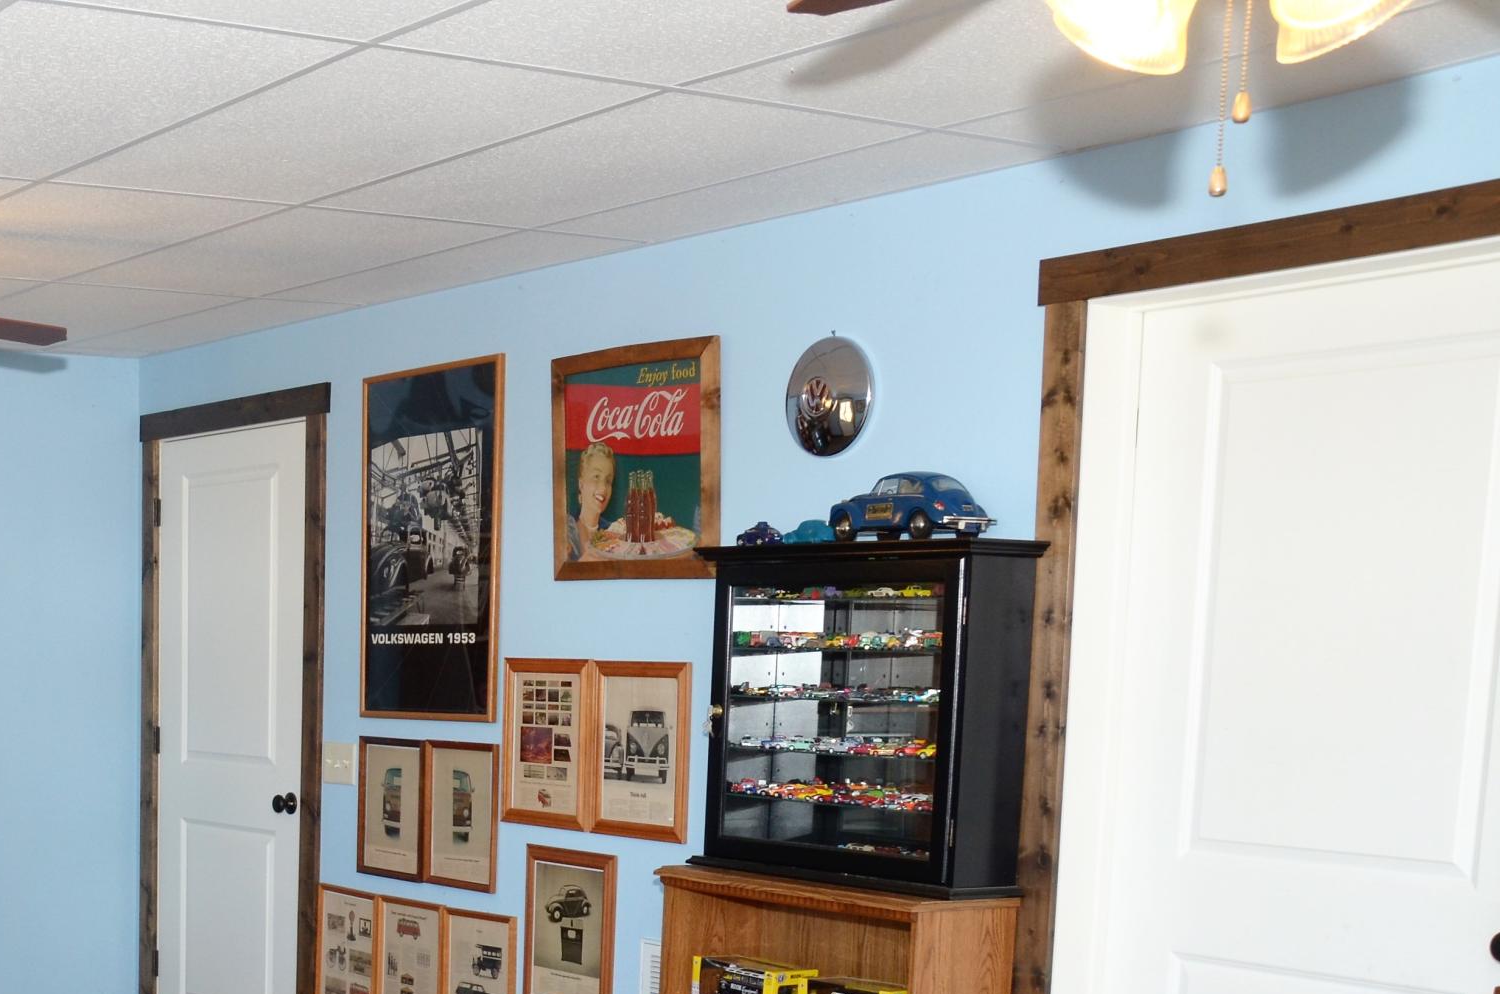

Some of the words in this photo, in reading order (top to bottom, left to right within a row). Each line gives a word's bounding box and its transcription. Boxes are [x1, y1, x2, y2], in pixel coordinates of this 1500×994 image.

[636, 367, 669, 387] Enjoy
[671, 361, 697, 381] food
[586, 388, 688, 443] Coca-Cola
[371, 632, 444, 645] VOLKSWAGEN
[446, 631, 477, 645] 1953
